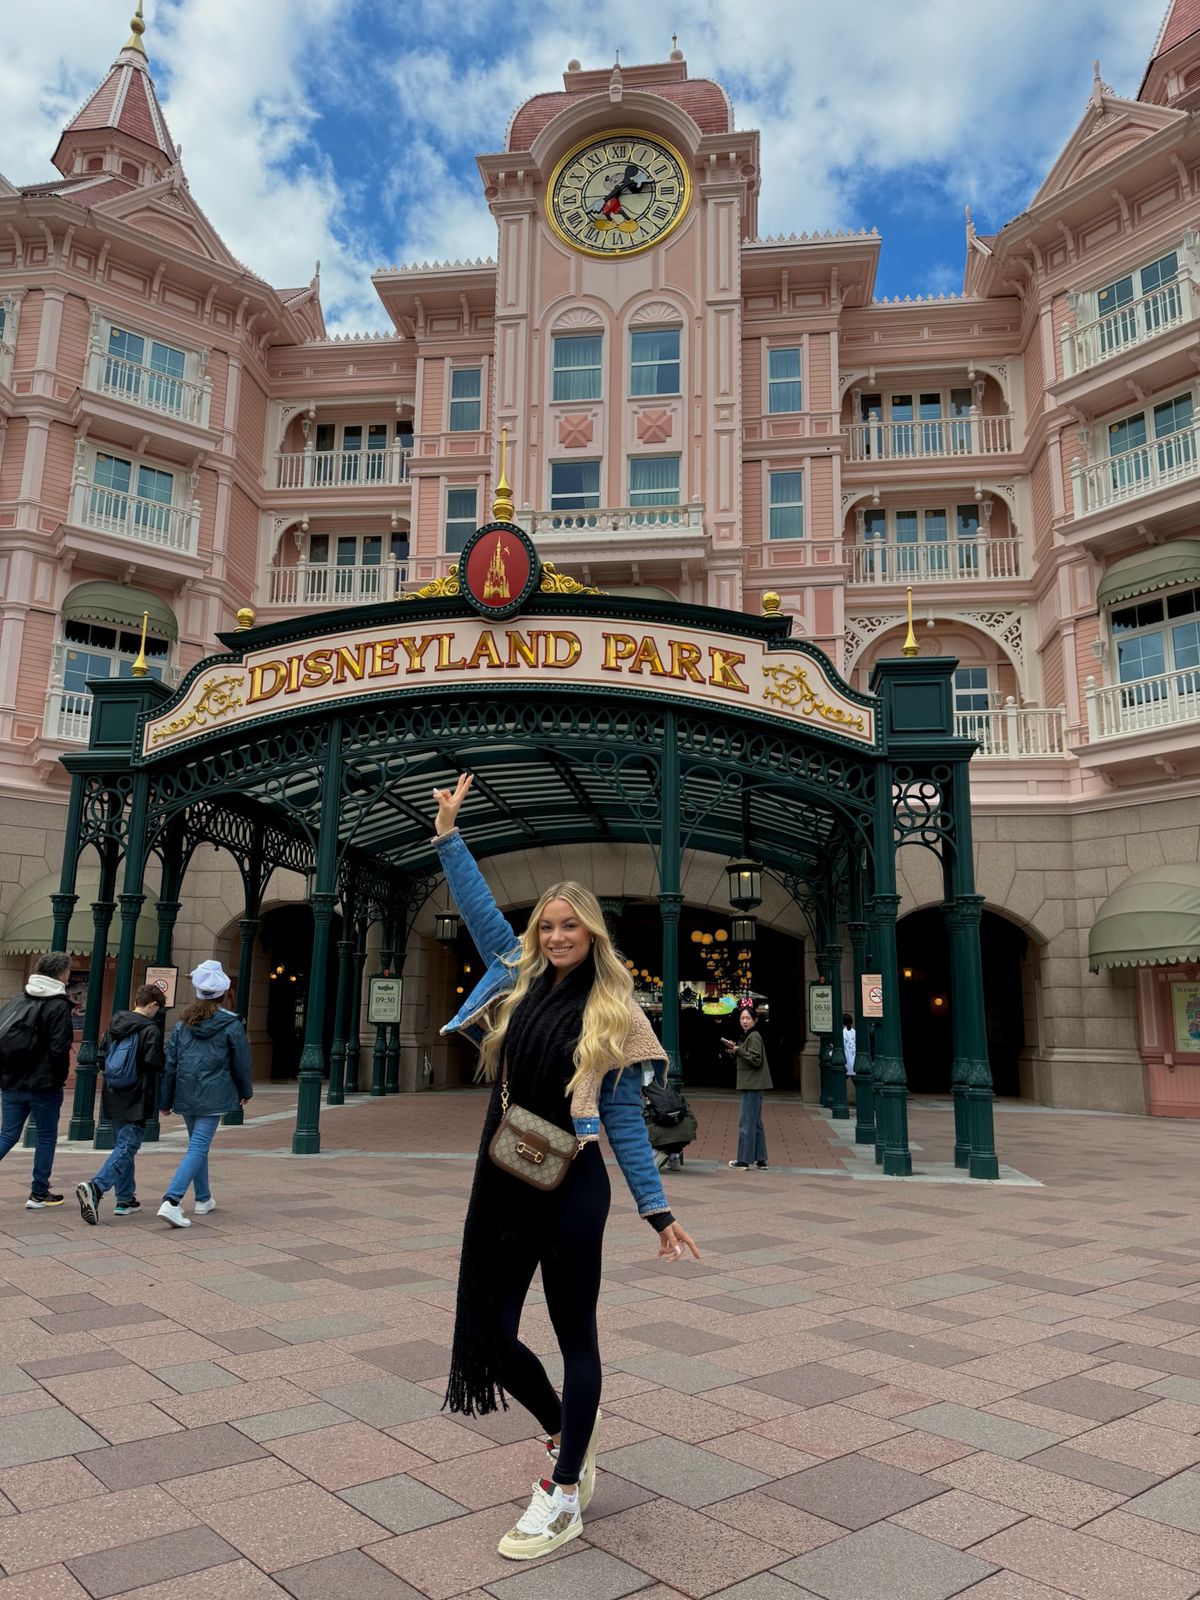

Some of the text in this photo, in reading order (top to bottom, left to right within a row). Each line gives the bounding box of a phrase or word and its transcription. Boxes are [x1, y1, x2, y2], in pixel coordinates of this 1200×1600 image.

[612, 146, 626, 158] XII
[587, 153, 602, 167] XI
[654, 164, 668, 175] II
[569, 172, 584, 182] X
[661, 186, 674, 195] III
[563, 194, 577, 204] IX
[653, 206, 669, 220] IIII
[567, 211, 584, 229] VIII
[585, 226, 600, 243] VII
[639, 225, 650, 237] V
[612, 232, 624, 245] VI
[246, 630, 750, 705] DISNEYLAND PARK
